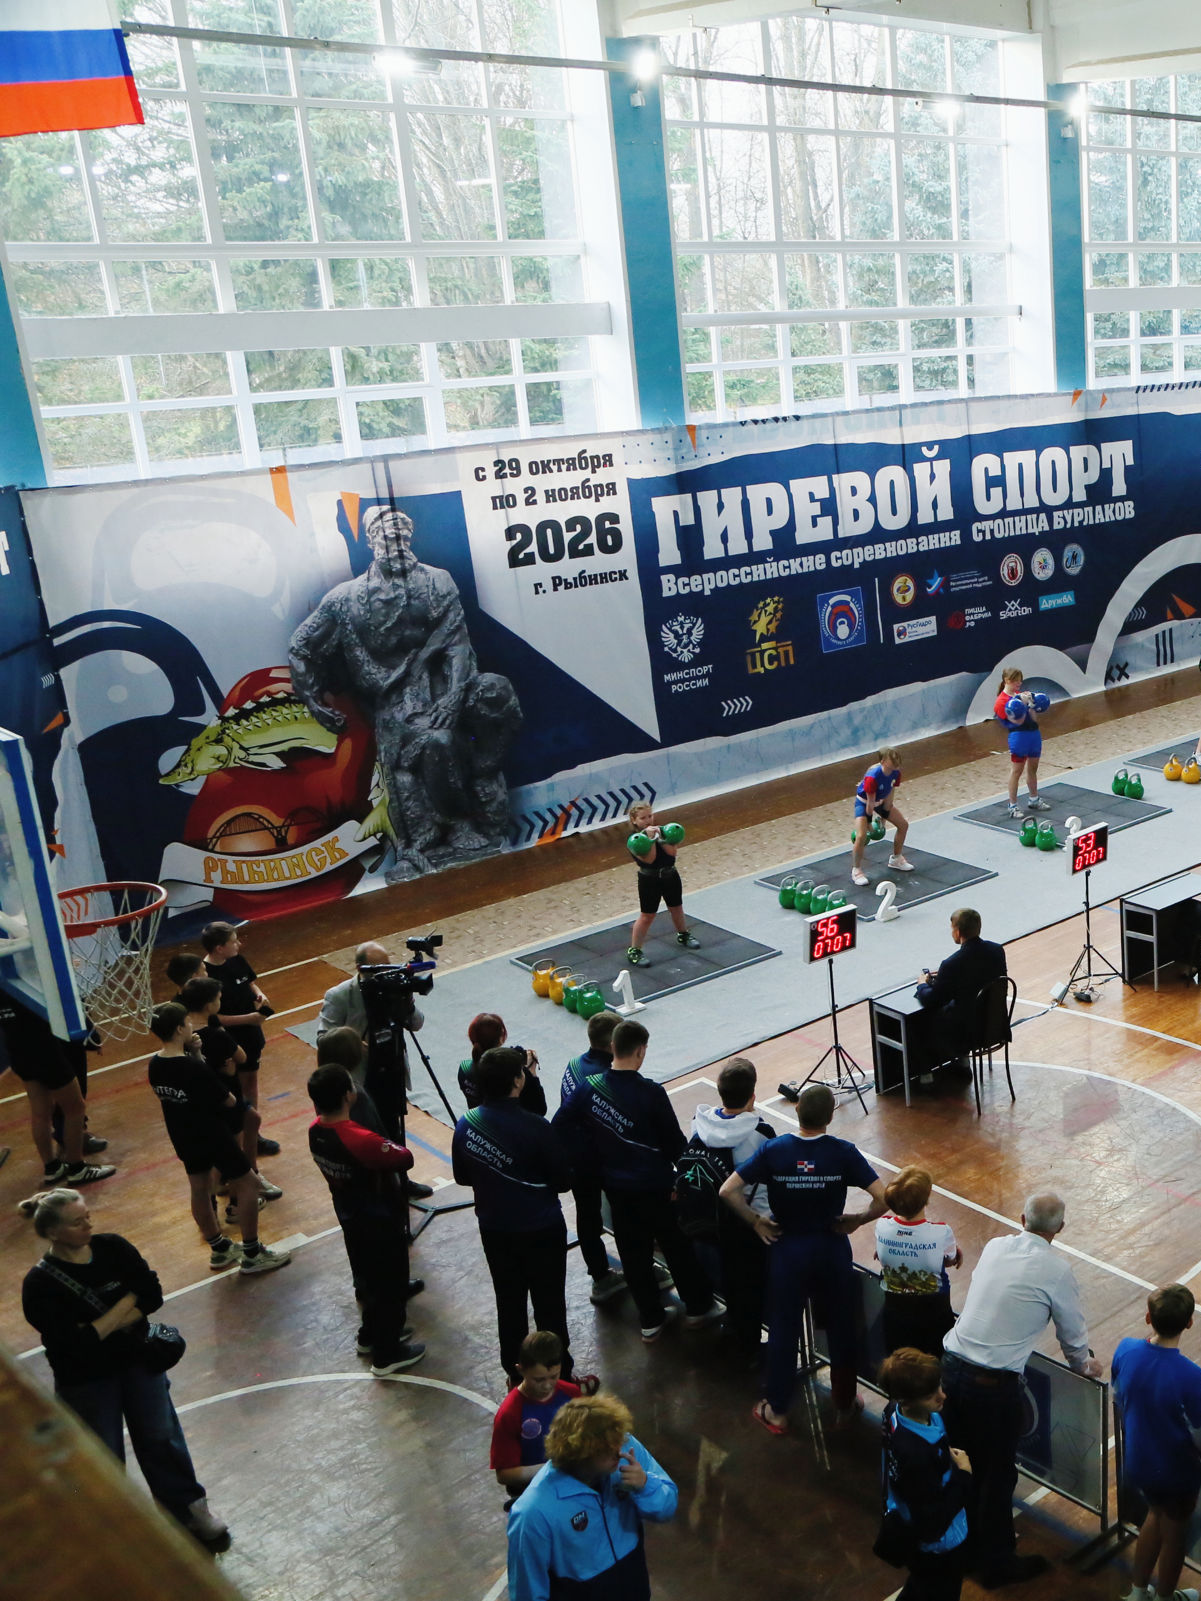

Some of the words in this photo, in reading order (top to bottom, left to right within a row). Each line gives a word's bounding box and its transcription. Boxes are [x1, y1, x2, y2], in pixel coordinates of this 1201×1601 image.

[474, 466, 487, 482] с
[494, 457, 522, 479] 29
[528, 448, 614, 477] октября
[491, 493, 518, 511] по
[523, 486, 538, 507] 2
[544, 477, 618, 504] ноября
[650, 444, 955, 568] ГИРЕВОЙ
[970, 440, 1135, 515] СПОРТ
[504, 511, 623, 569] 2026
[660, 555, 827, 598] Всероссийские
[831, 529, 961, 569] соревнования
[971, 515, 1050, 543] СТОЛИЦА
[1053, 500, 1135, 530] БУРЛАКОВ
[533, 581, 547, 596] г.
[552, 568, 629, 593] Рыбинск
[663, 664, 713, 683] МИНСПОРТ
[745, 643, 795, 674] ЦСП
[671, 678, 710, 694] РОССИИ
[1075, 847, 1104, 870] 0707
[1078, 832, 1096, 855] 53
[202, 835, 349, 885] РЫБИНСК
[875, 880, 899, 922] 2
[817, 915, 839, 940] 56
[813, 932, 852, 958] 0707
[612, 969, 636, 1010] 1
[591, 1093, 634, 1128] КАЛУЖСКАЯ
[591, 1105, 625, 1135] ОБЛАСТЬ
[465, 1128, 514, 1166] КАЛУЖСКАЯ
[466, 1140, 503, 1169] ОБЛАСТЬ
